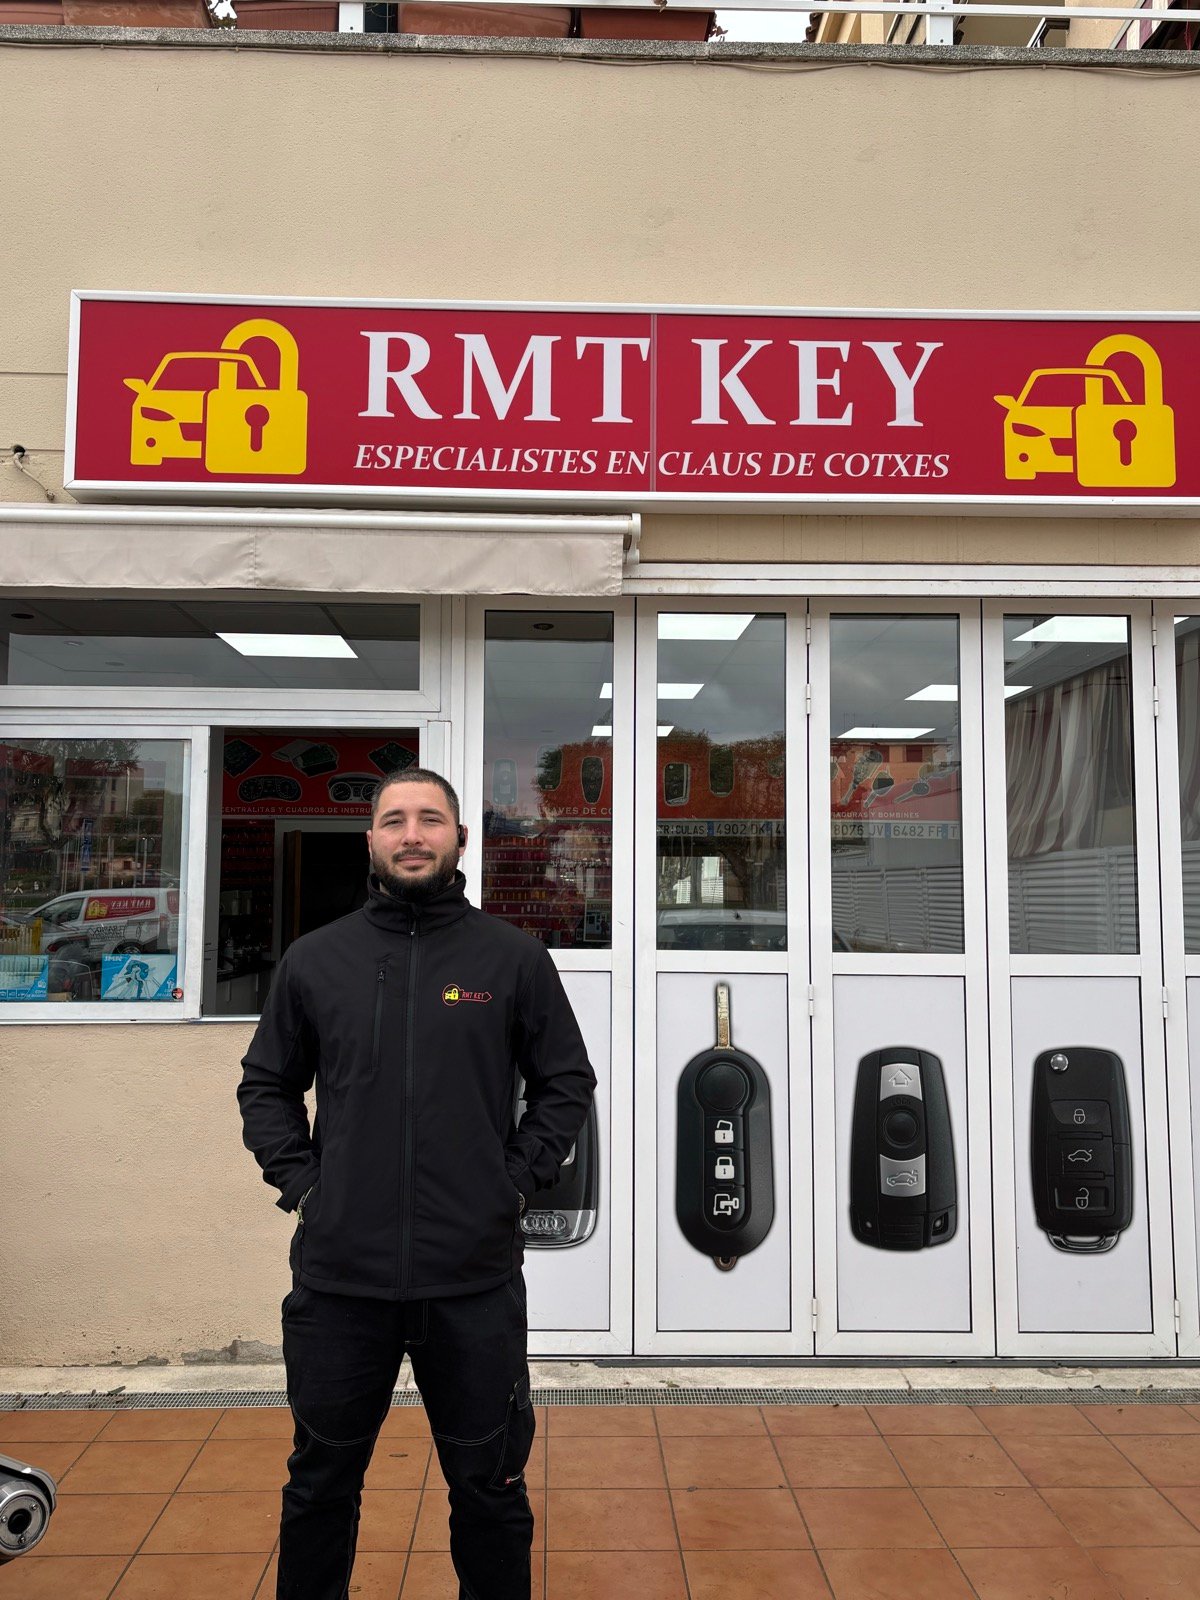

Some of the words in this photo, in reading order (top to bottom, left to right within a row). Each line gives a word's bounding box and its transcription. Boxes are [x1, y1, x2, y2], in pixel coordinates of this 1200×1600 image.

[357, 330, 651, 424] RMT
[690, 338, 944, 428] KEY
[353, 444, 598, 475] ESPECIALISTES
[604, 449, 651, 476] EN
[658, 451, 763, 478] CLAUS
[770, 452, 816, 478] DE
[823, 453, 951, 480] COTXES
[583, 807, 597, 815] DE
[716, 823, 747, 835] 4902
[834, 823, 864, 836] 8076
[893, 825, 924, 837] 6482
